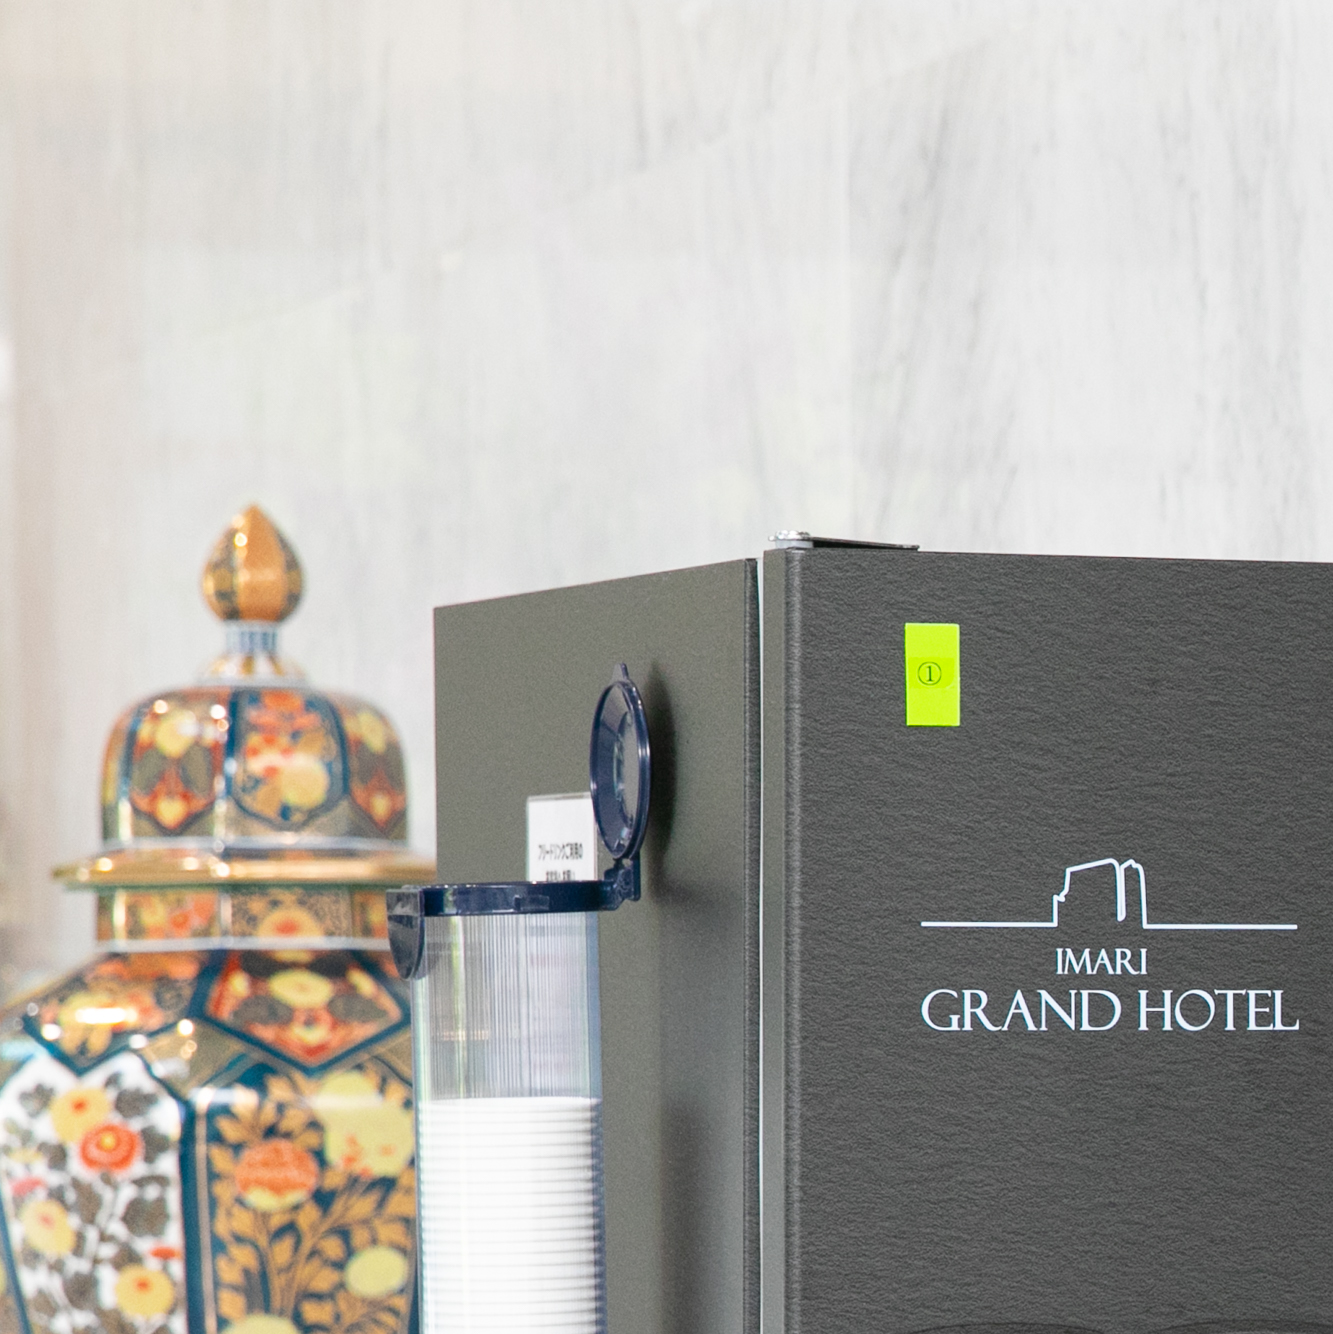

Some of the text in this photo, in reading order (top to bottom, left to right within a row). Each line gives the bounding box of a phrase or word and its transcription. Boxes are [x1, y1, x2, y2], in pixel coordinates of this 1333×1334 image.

[1055, 948, 1148, 975] IMARI
[920, 988, 1300, 1032] GRAND HOTEL
